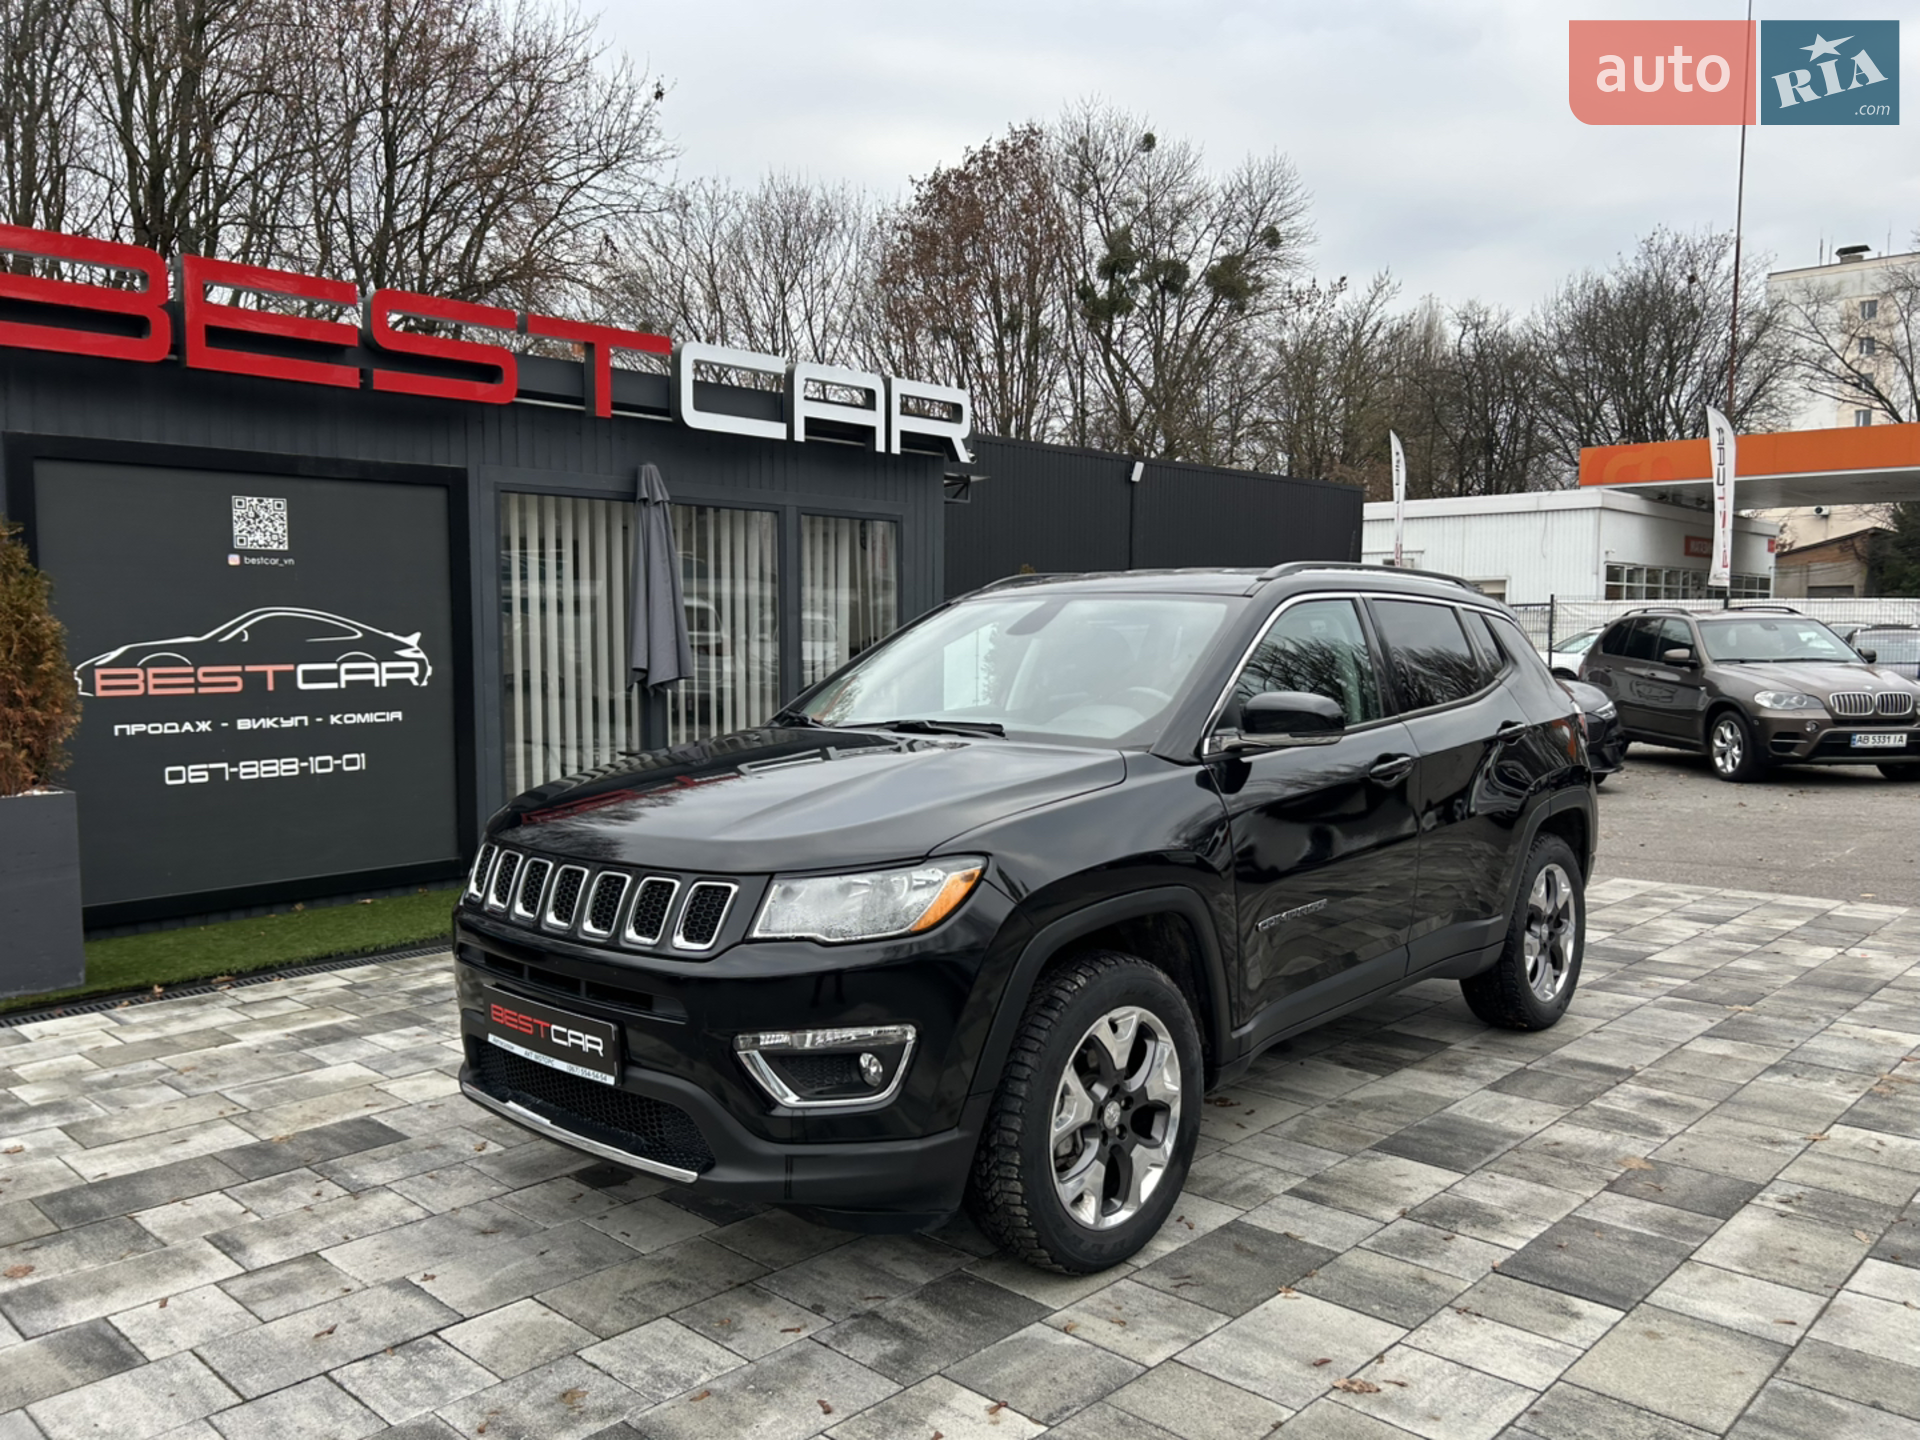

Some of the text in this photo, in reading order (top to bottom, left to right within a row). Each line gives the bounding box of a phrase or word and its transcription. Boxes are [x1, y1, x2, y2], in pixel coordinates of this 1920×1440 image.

[244, 556, 295, 567] bestcar_vn
[94, 661, 420, 697] BESTCAR
[113, 720, 212, 736] ПРОДАЖ
[236, 715, 309, 731] ВИКУП
[330, 711, 403, 725] КОМІСІЯ
[164, 753, 366, 785] 067-888-10-01
